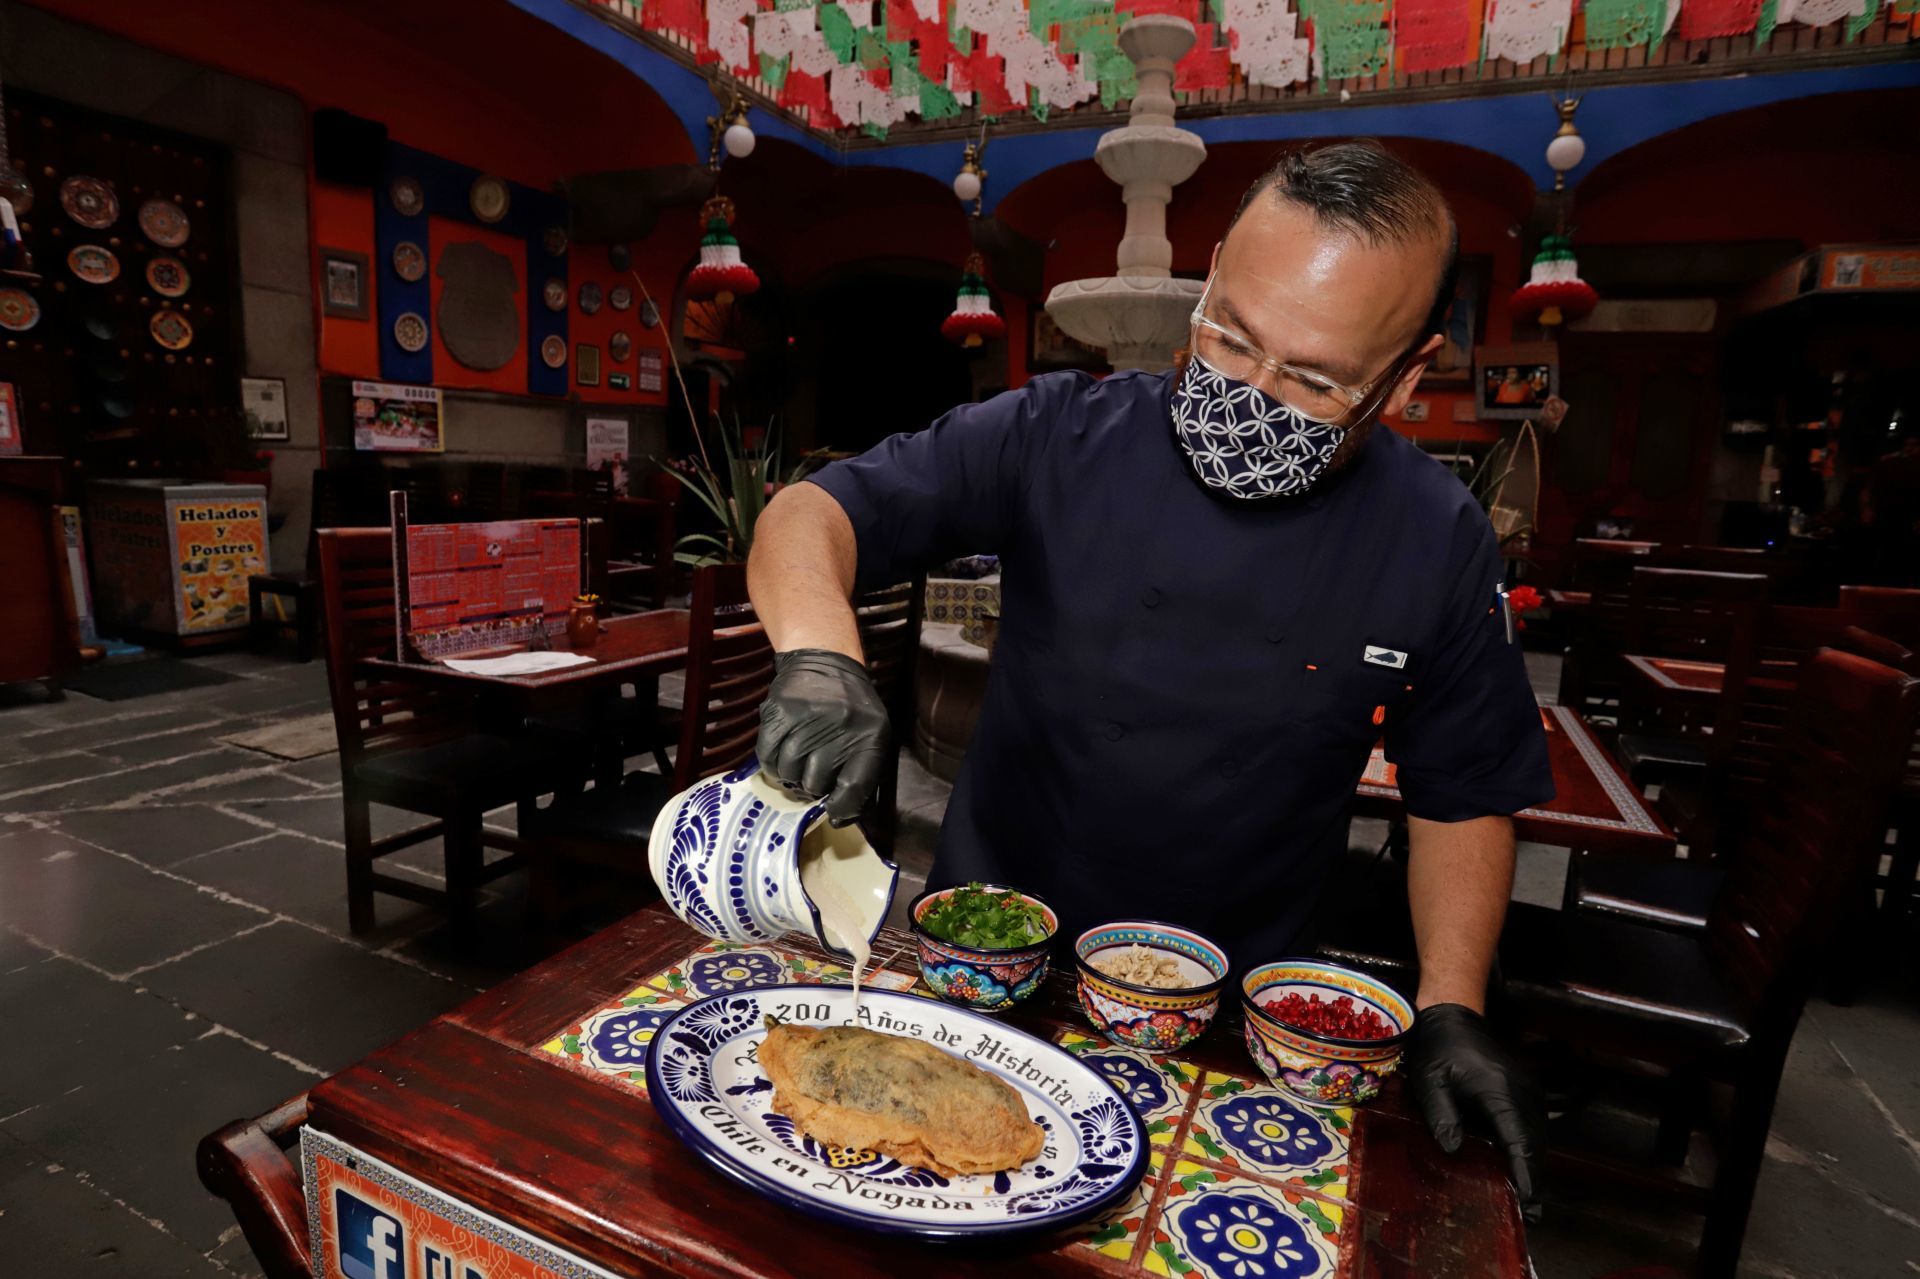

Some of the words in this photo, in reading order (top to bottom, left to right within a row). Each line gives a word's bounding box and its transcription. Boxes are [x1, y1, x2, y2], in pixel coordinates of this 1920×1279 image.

[179, 508, 259, 522] Helados
[216, 526, 227, 538] y
[191, 543, 254, 557] Postres
[776, 1003, 831, 1023] 200
[844, 1005, 924, 1037] Años
[932, 1023, 963, 1048] de
[964, 1033, 1075, 1108] Historia
[699, 1105, 766, 1157] Chile
[771, 1156, 810, 1178] en
[811, 1171, 976, 1211] Nogada
